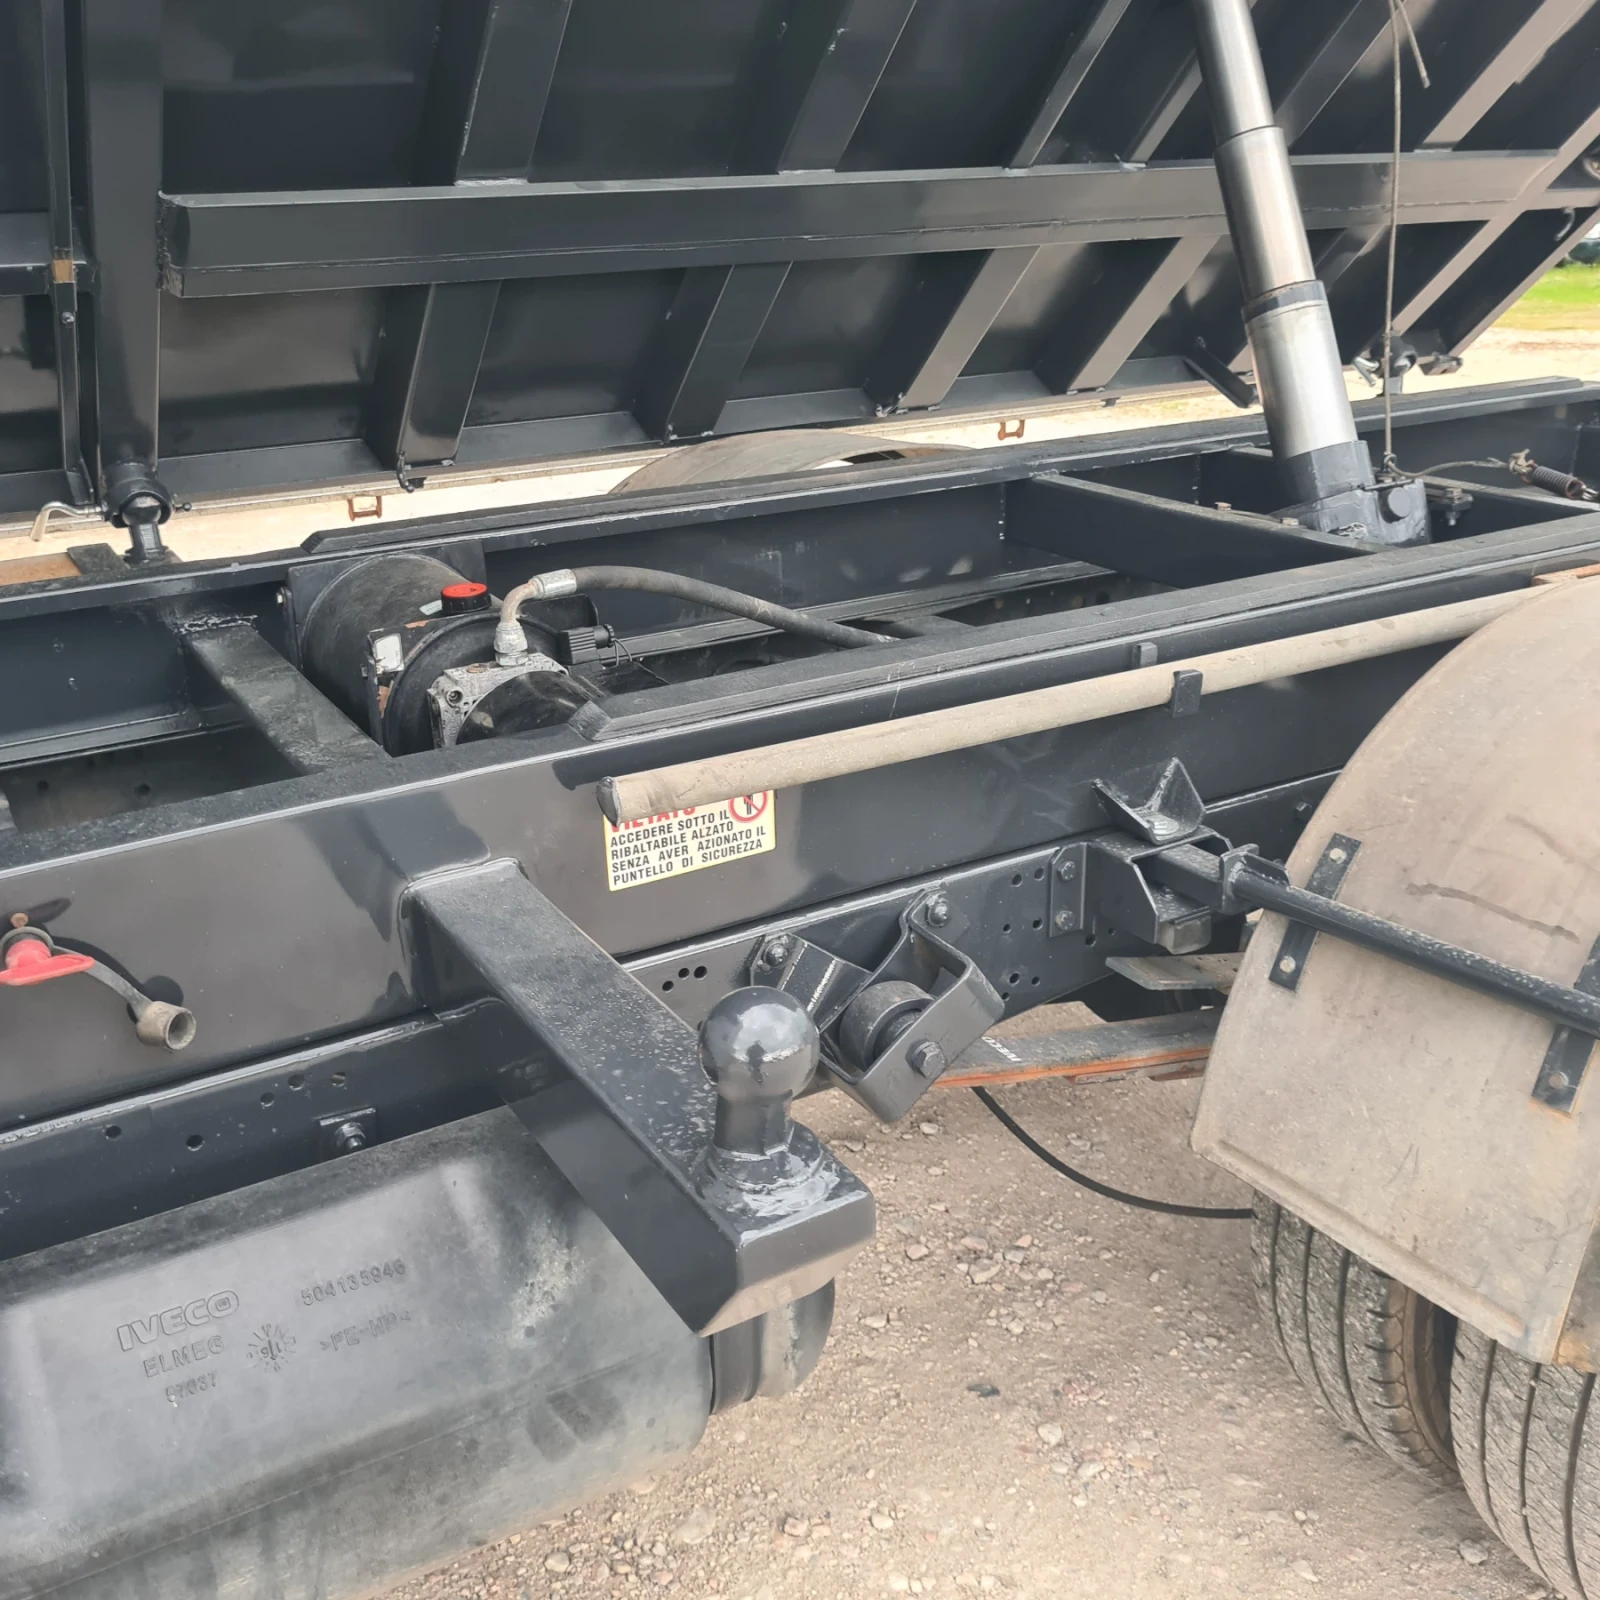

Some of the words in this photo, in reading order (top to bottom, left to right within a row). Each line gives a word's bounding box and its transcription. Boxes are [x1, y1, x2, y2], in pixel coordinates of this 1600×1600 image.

[611, 823, 673, 847] ACCEDERE
[678, 813, 715, 831] SOTTO
[720, 810, 730, 821] IL
[611, 833, 687, 860] RIBALTABILE
[692, 821, 734, 840] ALZATO
[612, 855, 650, 872] SENZA
[659, 846, 689, 861] AVER
[698, 829, 751, 851] AZIONATO
[757, 826, 766, 836] IL
[613, 862, 674, 885] PUNTELLO
[682, 857, 694, 868] DI
[702, 839, 763, 863] SICUREZZA
[116, 1290, 240, 1351] IVECO
